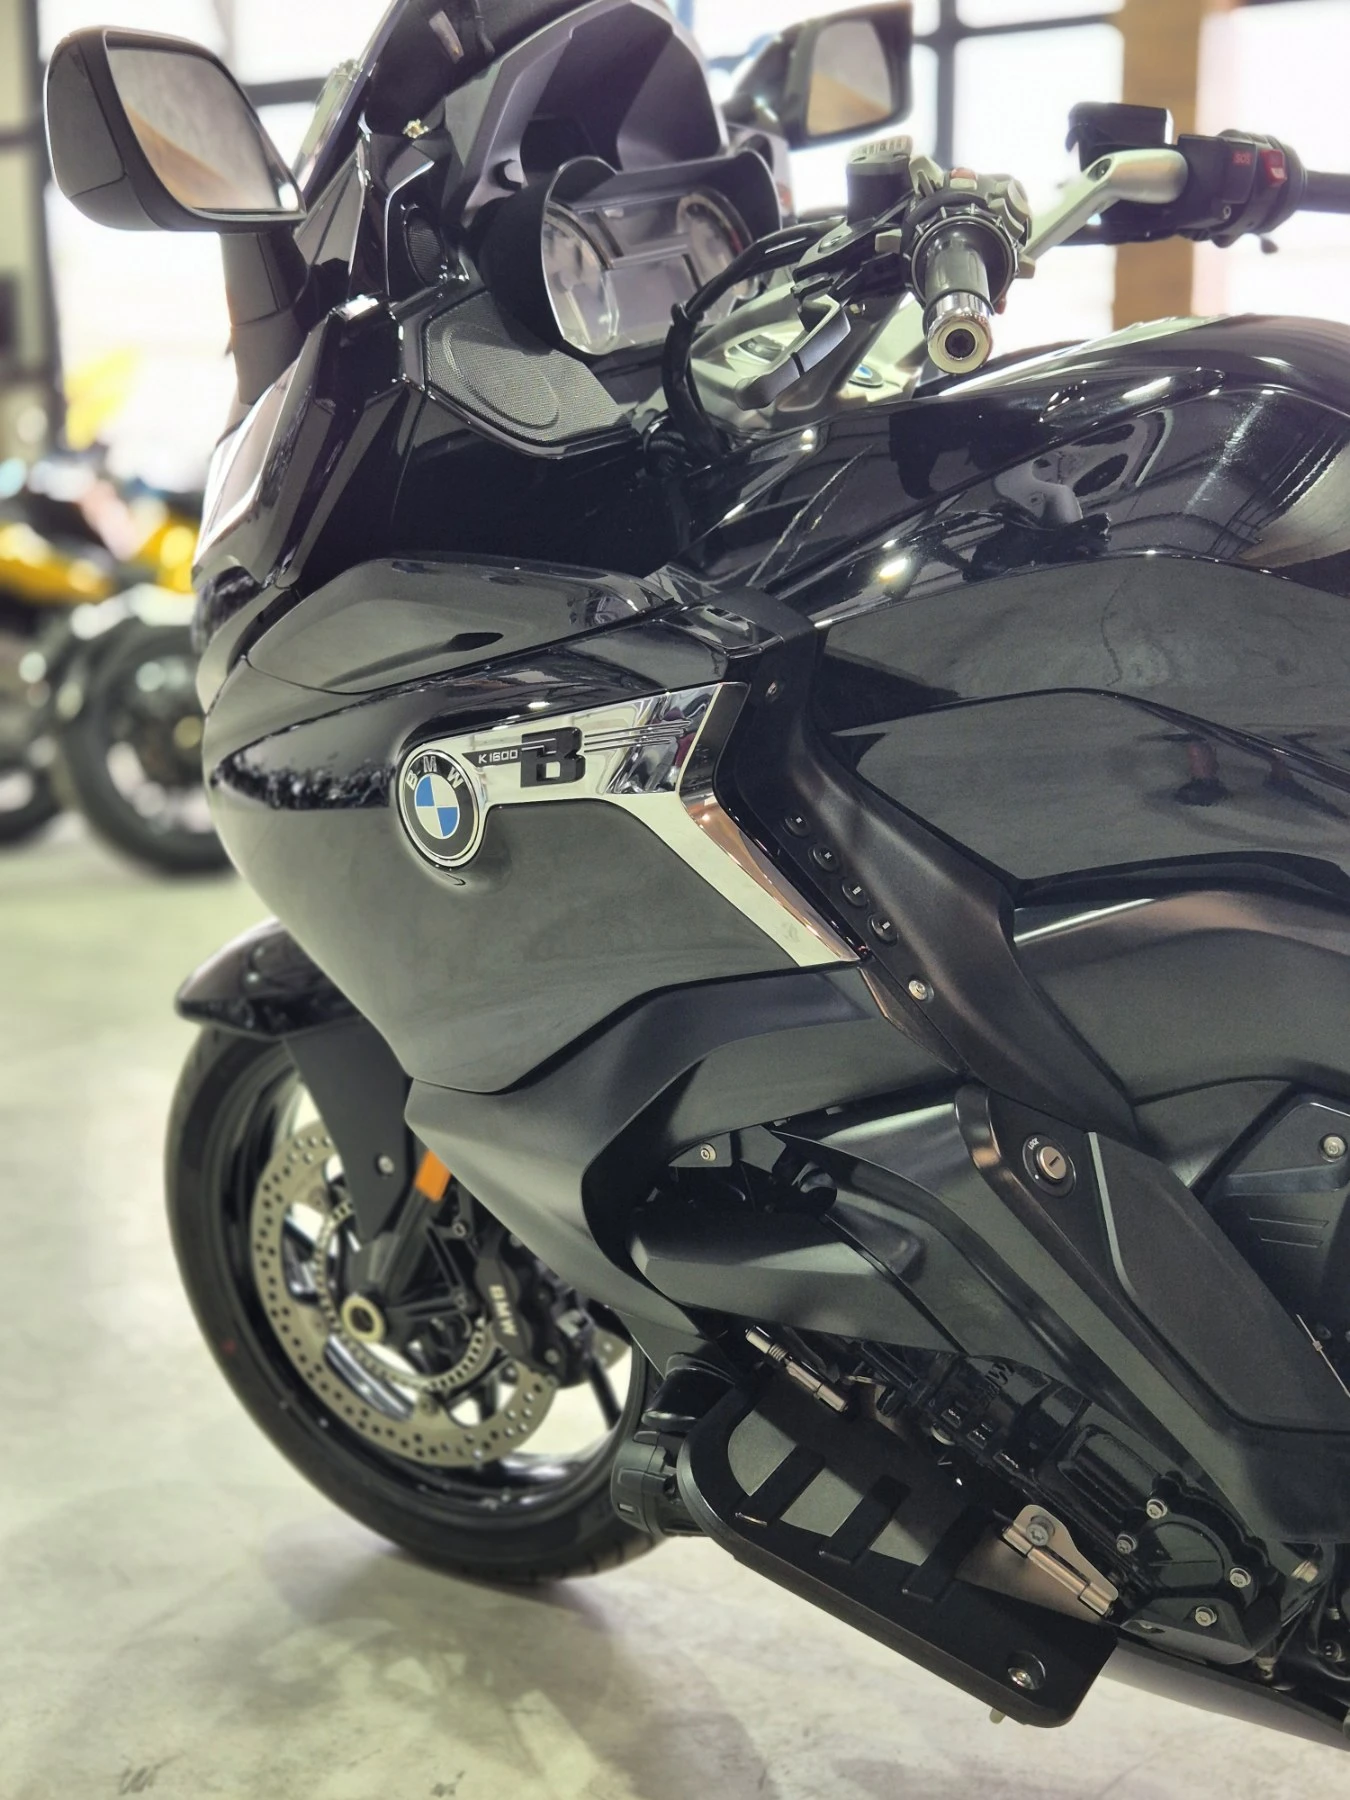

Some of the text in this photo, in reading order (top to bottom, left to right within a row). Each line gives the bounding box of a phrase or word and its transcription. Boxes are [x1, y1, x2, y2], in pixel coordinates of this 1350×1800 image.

[478, 754, 487, 764] K
[489, 749, 518, 763] 1600
[404, 756, 465, 791] BMW
[1027, 1137, 1040, 1151] LOCK
[488, 1284, 519, 1337] BMW
